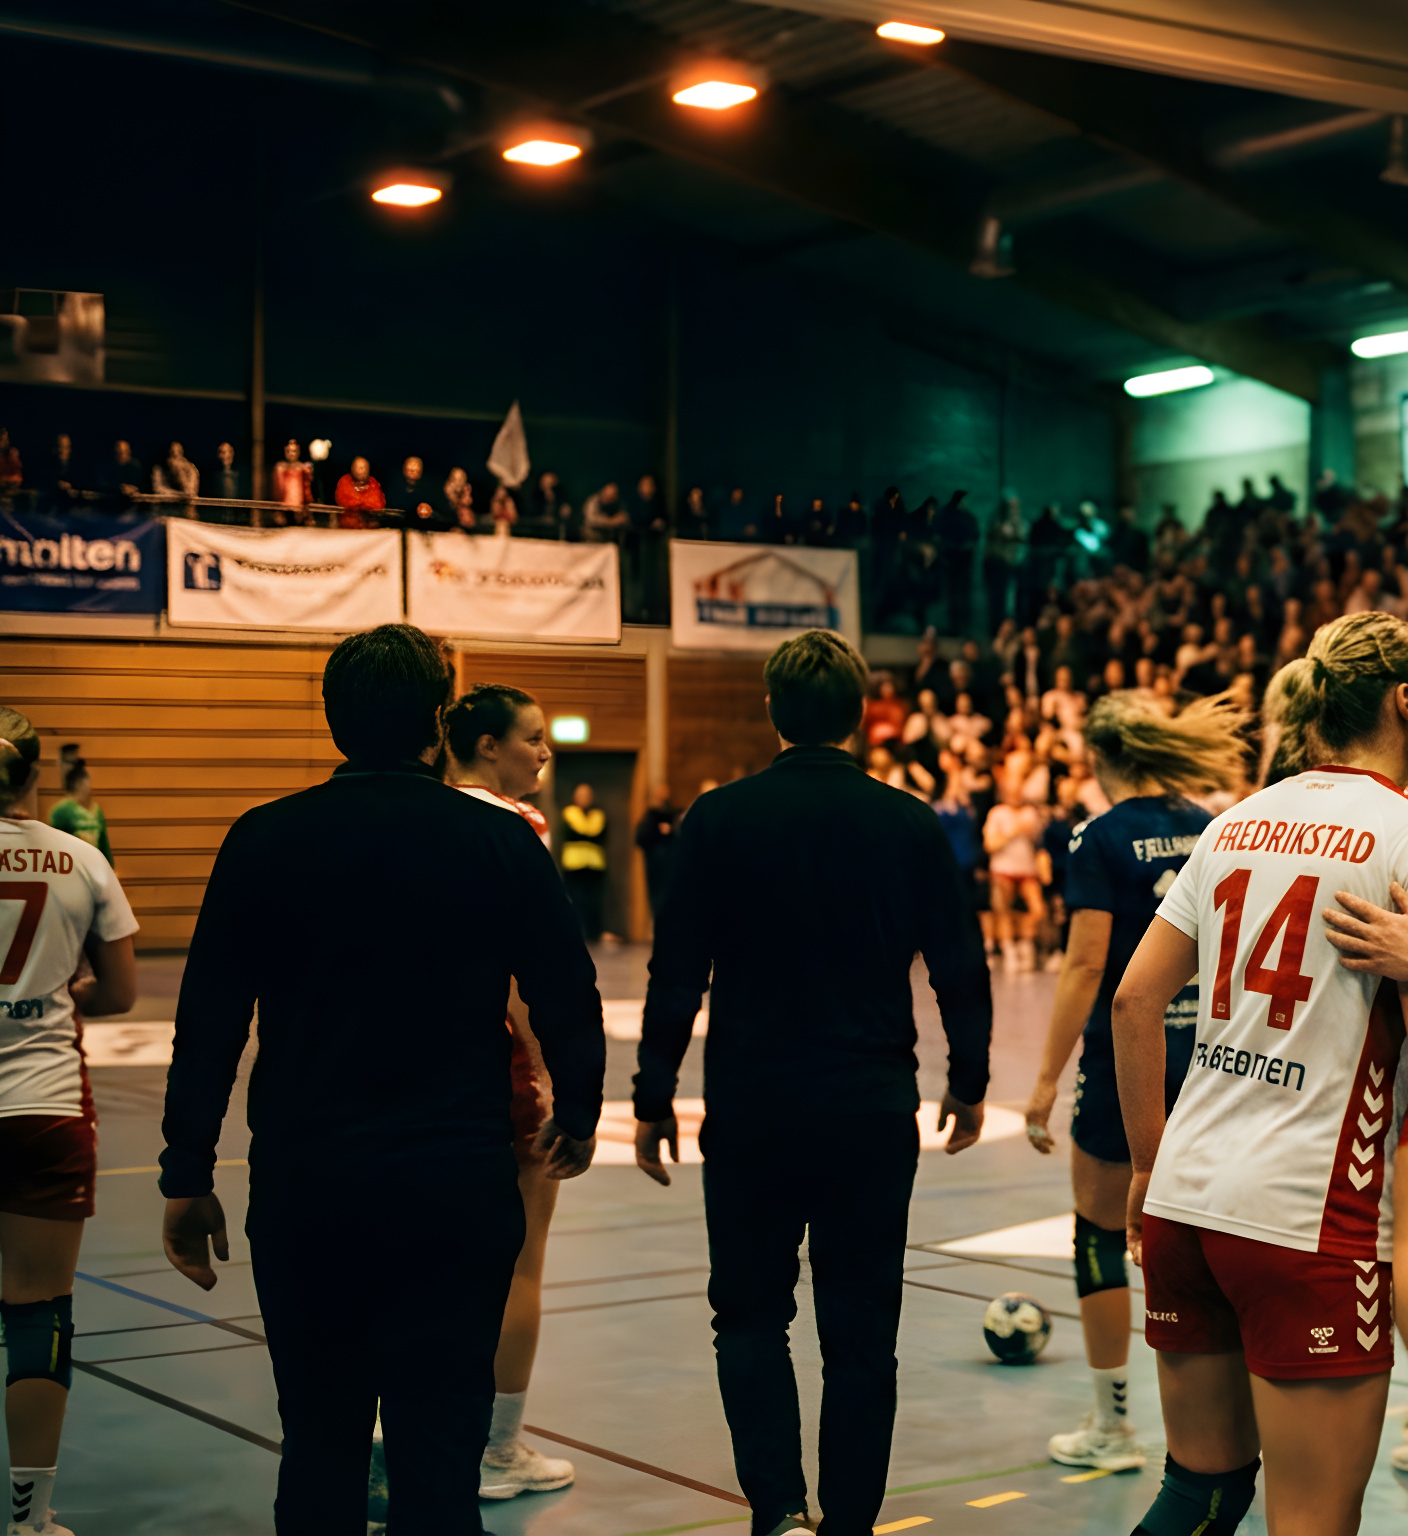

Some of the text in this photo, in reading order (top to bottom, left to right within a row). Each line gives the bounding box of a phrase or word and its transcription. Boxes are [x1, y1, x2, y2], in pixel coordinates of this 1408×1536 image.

[0, 533, 141, 572] molten
[1213, 820, 1376, 864] FREDRIKSTAD
[0, 881, 48, 985] 7
[1211, 868, 1320, 1031] 14
